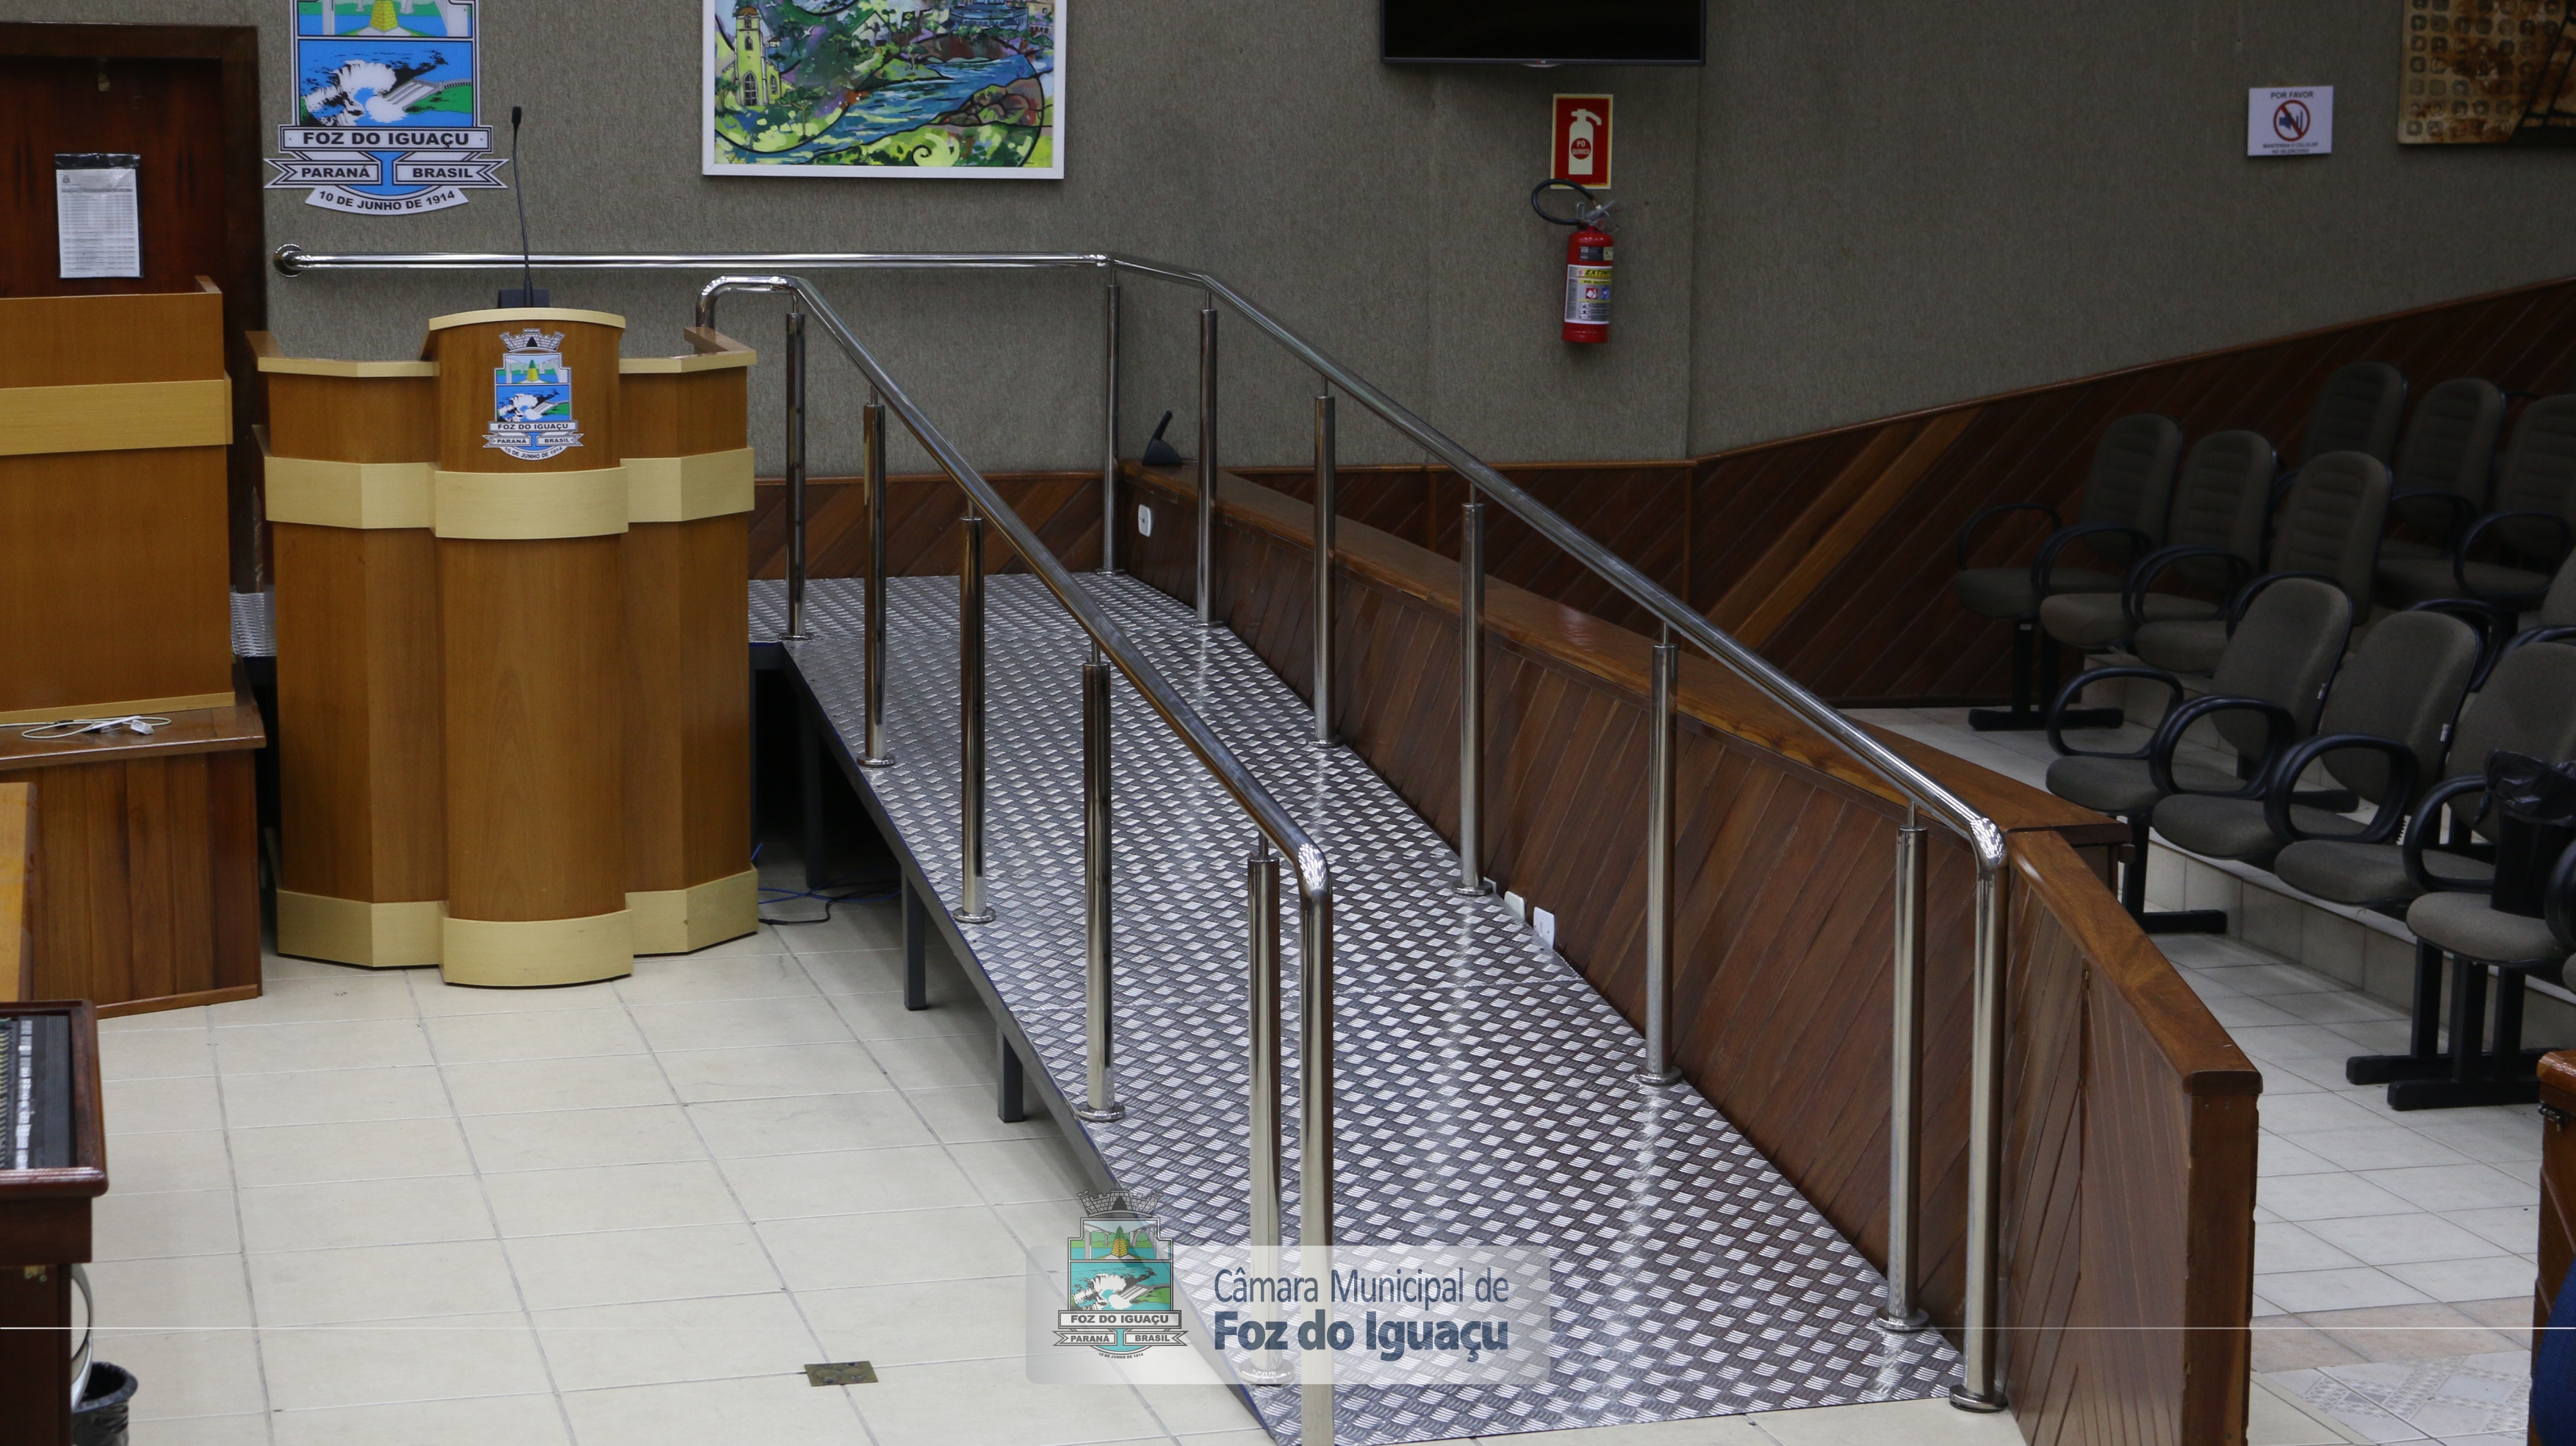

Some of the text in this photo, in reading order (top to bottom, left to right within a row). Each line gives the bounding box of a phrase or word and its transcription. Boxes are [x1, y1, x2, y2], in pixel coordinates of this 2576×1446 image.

[303, 132, 469, 148] FOZ DO IGUAÇU
[301, 165, 473, 178] PARANÁ BRASIL
[320, 190, 455, 210] 10 DE JUNHO DE 1914
[550, 446, 563, 455] 1914
